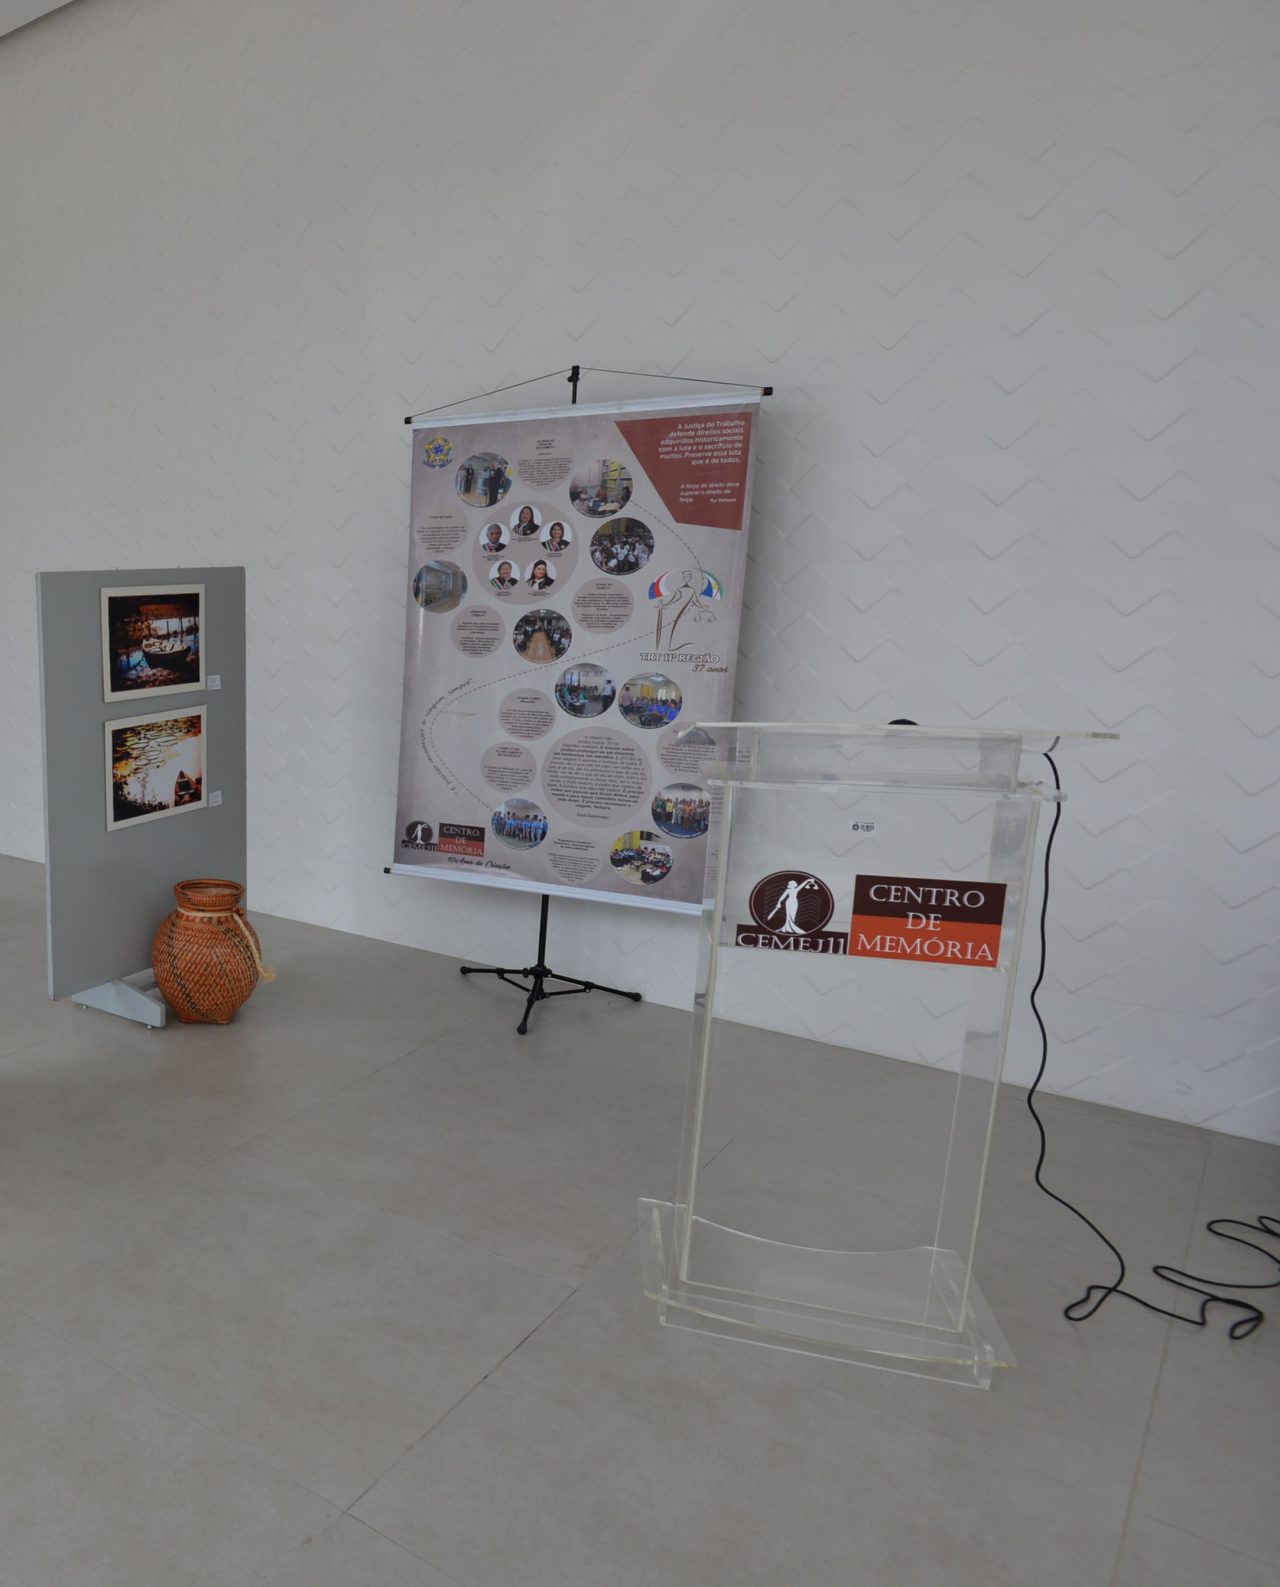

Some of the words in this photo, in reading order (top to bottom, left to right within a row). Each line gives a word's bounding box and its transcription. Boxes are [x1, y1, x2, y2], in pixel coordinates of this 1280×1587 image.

[683, 422, 705, 430] Justiça
[716, 419, 745, 427] Trabalho
[695, 434, 744, 443] historicamente
[640, 652, 661, 662] TRT
[678, 652, 720, 664] REGIÃO
[692, 664, 705, 672] 37
[705, 665, 729, 673] anos
[443, 825, 480, 837] CENTRO
[455, 836, 467, 844] DE
[439, 843, 483, 856] MEMÓRIA
[869, 883, 985, 908] CENTRO
[905, 911, 942, 932] DE
[736, 932, 847, 956] CEMEJ11
[856, 934, 994, 962] MEMÓRIA
